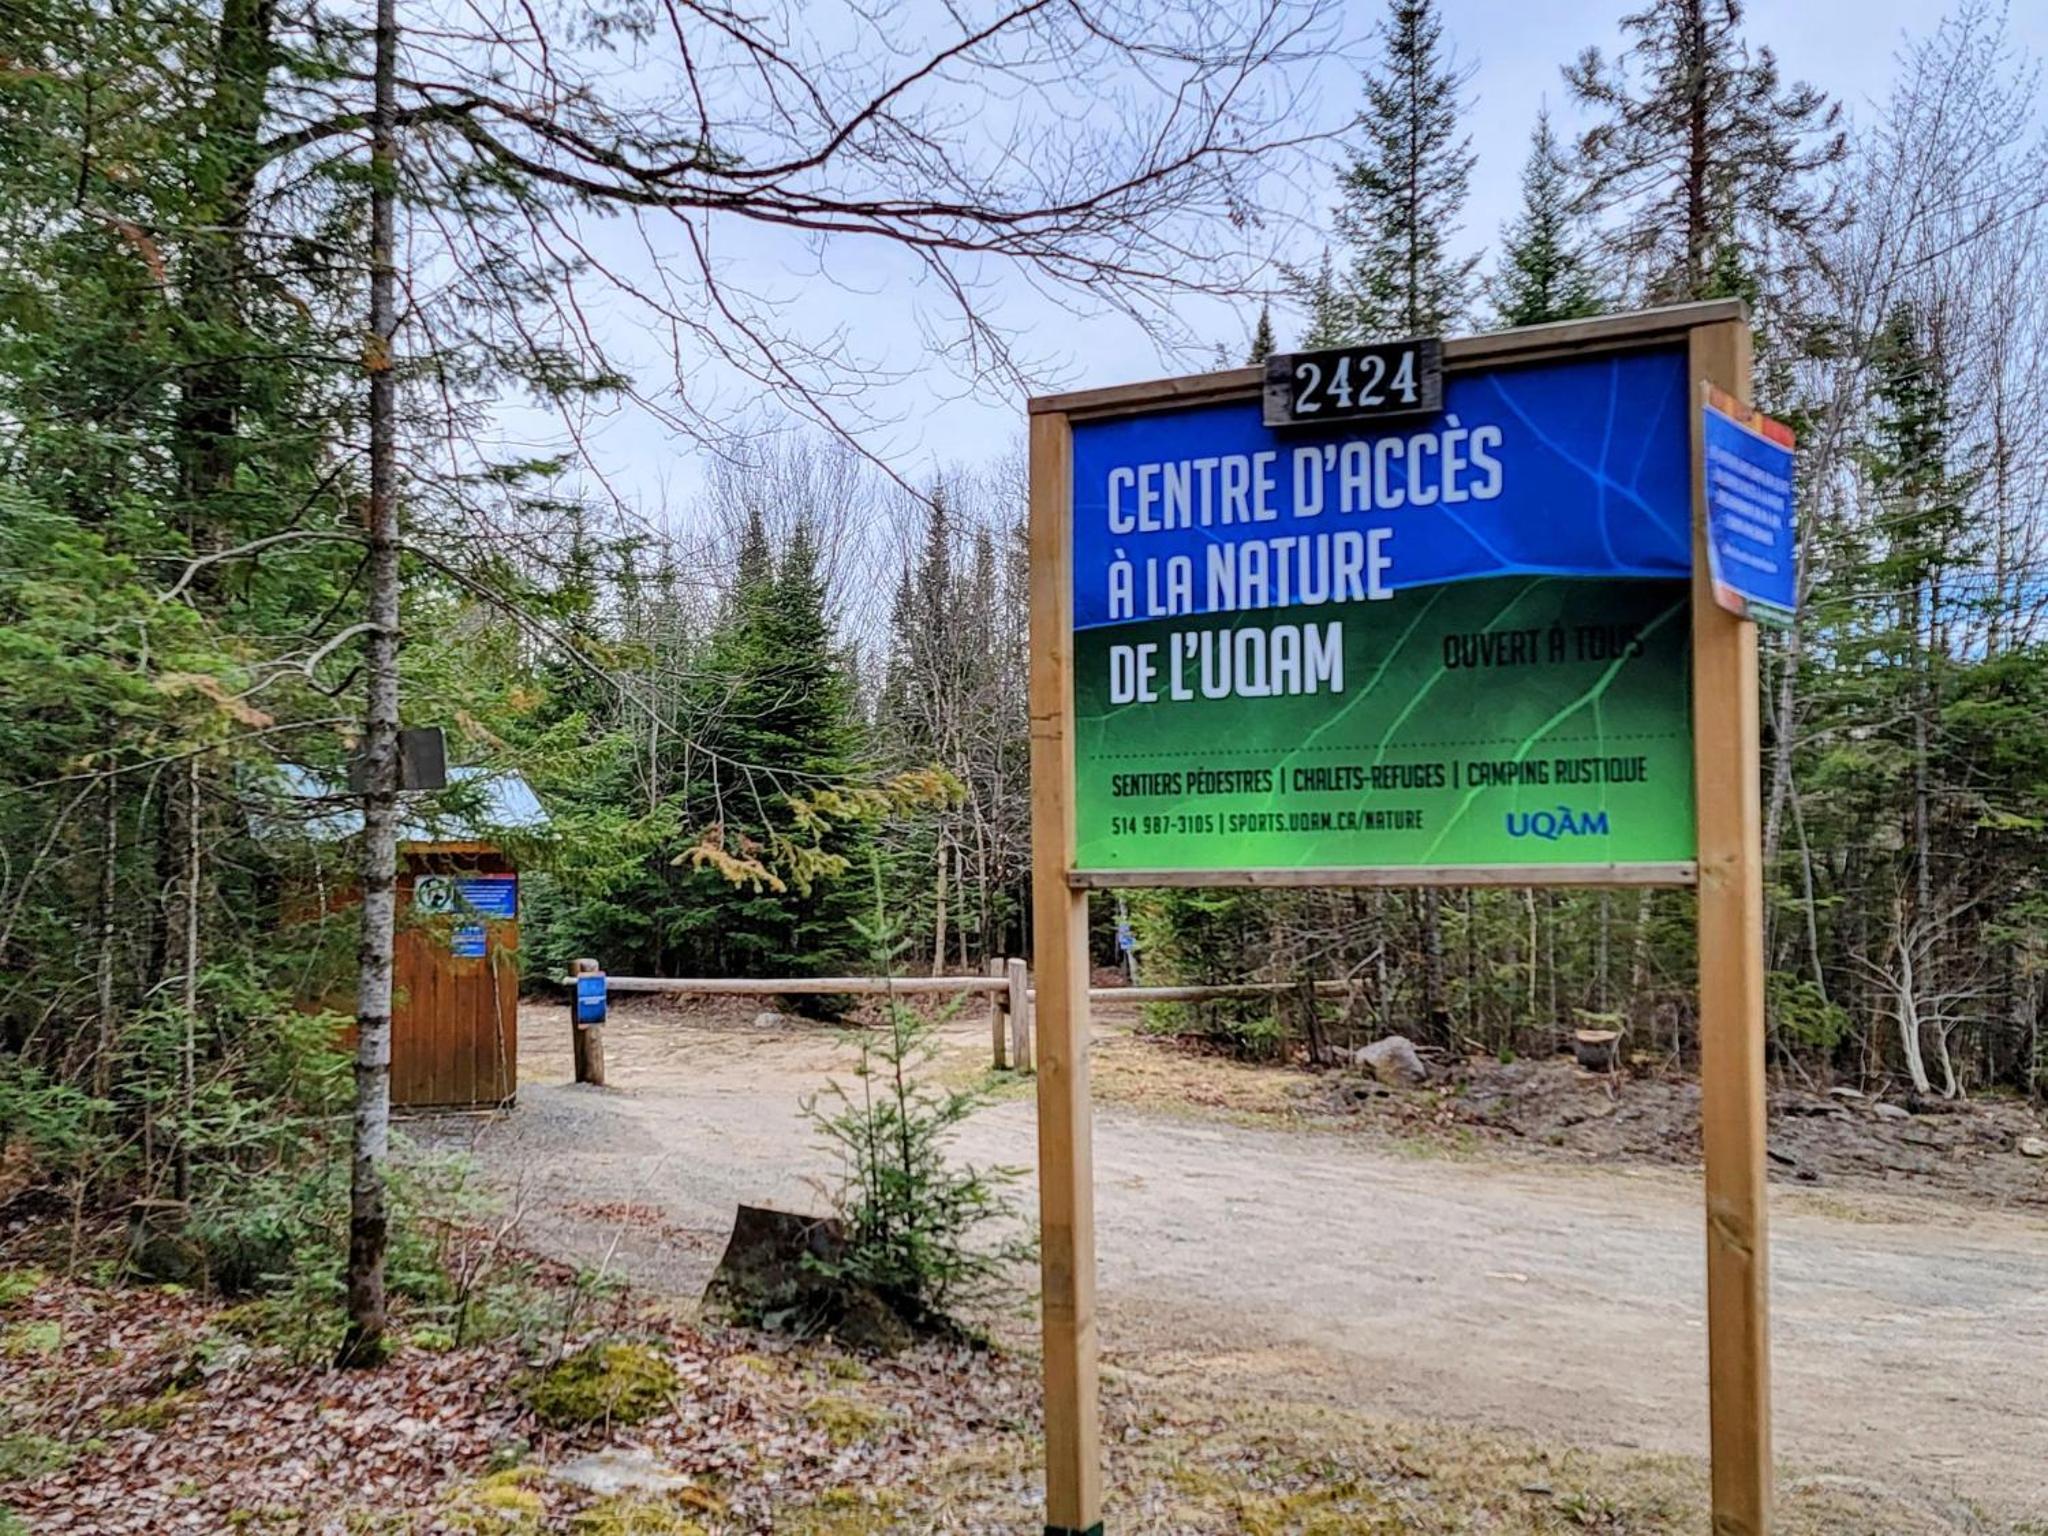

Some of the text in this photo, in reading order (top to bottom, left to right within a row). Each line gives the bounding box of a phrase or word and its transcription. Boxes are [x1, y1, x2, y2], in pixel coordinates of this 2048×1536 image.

[1295, 351, 1418, 413] 2424
[1108, 451, 1278, 535] CENTRE
[1108, 527, 1394, 620] À LA NATURE
[1443, 620, 1645, 669] OUVERT À TOUS
[1110, 643, 1158, 705] DE
[1112, 772, 1182, 797] SENTIERS
[1186, 766, 1273, 795] PÉDESTRES
[1293, 763, 1445, 792] CHALETS-REFUGES
[1467, 758, 1550, 787] CAMPING
[1555, 756, 1648, 783] RUSTIQUE
[1112, 816, 1137, 835] 514
[1143, 813, 1214, 834] 987-3105
[1506, 805, 1610, 840] UQÀM
